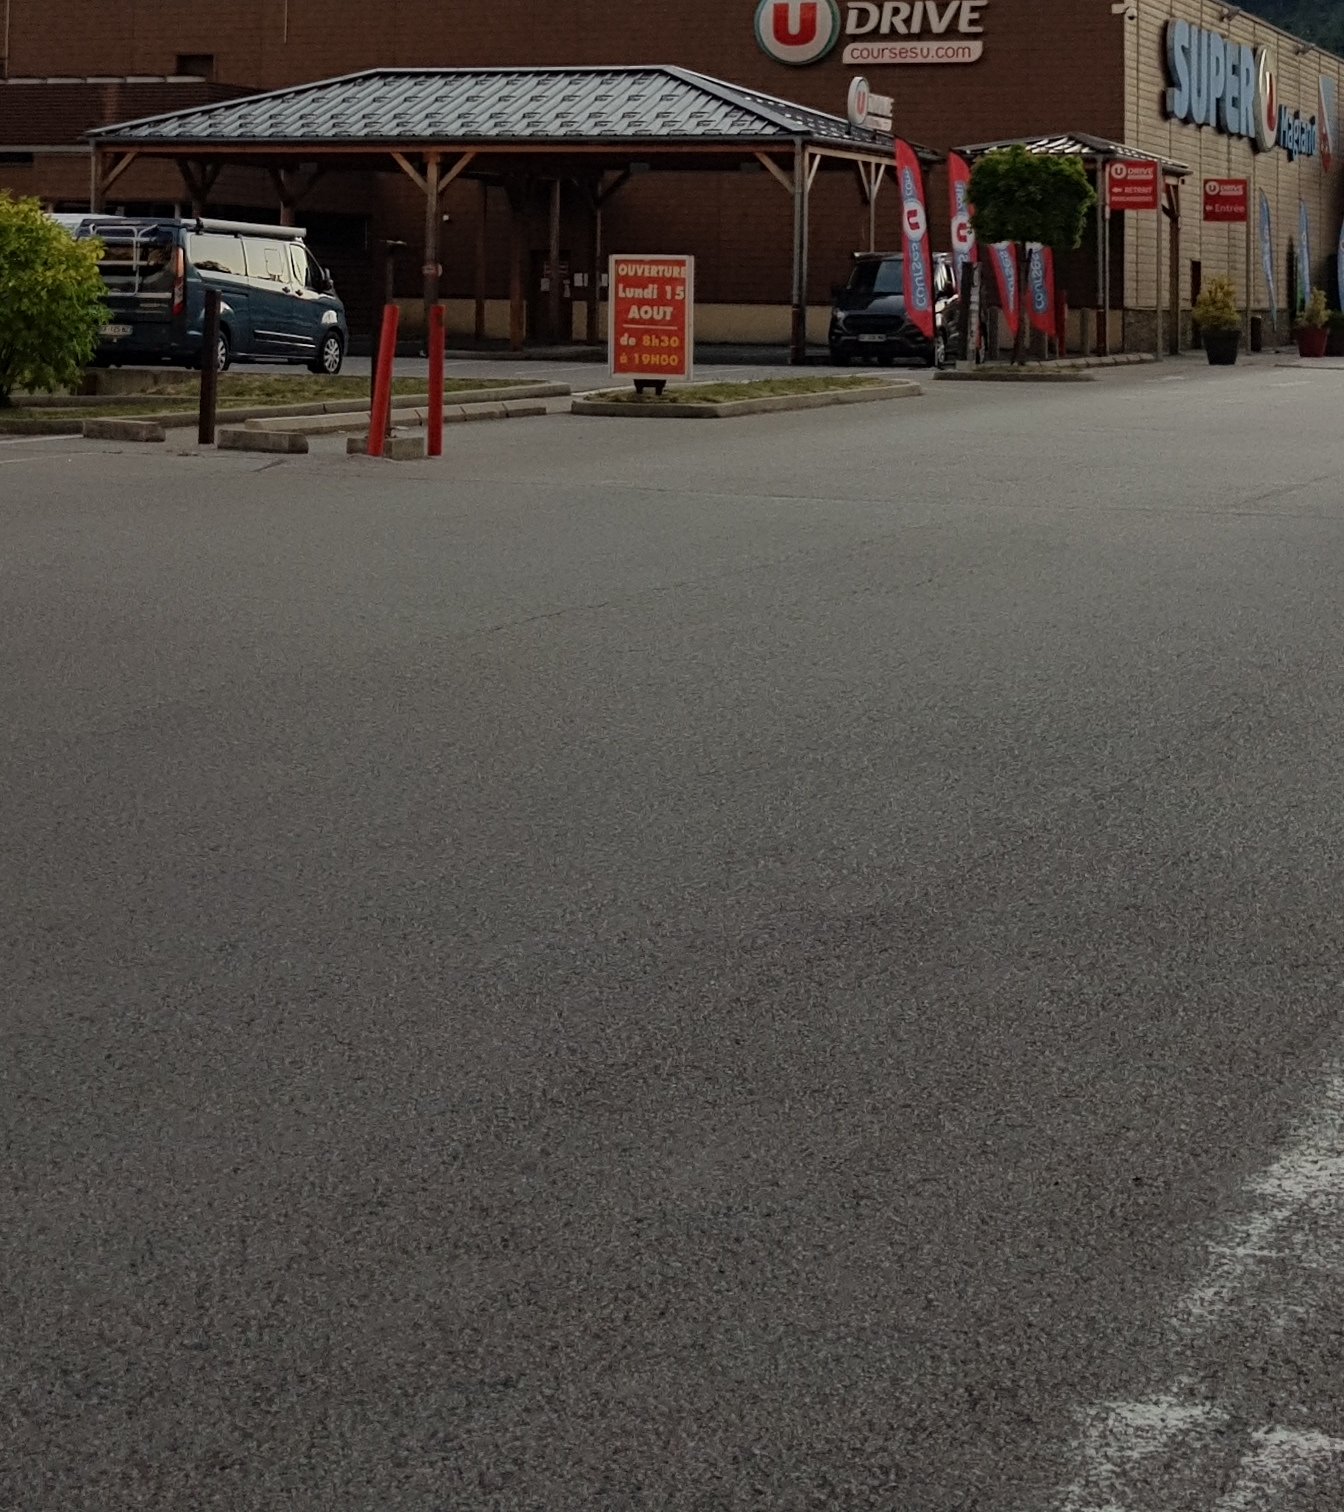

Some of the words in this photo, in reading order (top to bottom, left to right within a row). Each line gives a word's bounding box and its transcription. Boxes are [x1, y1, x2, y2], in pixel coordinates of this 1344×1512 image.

[772, 2, 817, 47] U
[845, 0, 989, 35] DRIVE
[850, 44, 972, 60] coursesu.com
[1168, 18, 1256, 138] SUPER
[618, 264, 687, 278] OUVERTURE
[618, 283, 658, 299] Lundi
[665, 285, 685, 300] 15
[628, 305, 674, 320] AOUT
[619, 333, 636, 346] de
[642, 334, 680, 347] 8h30
